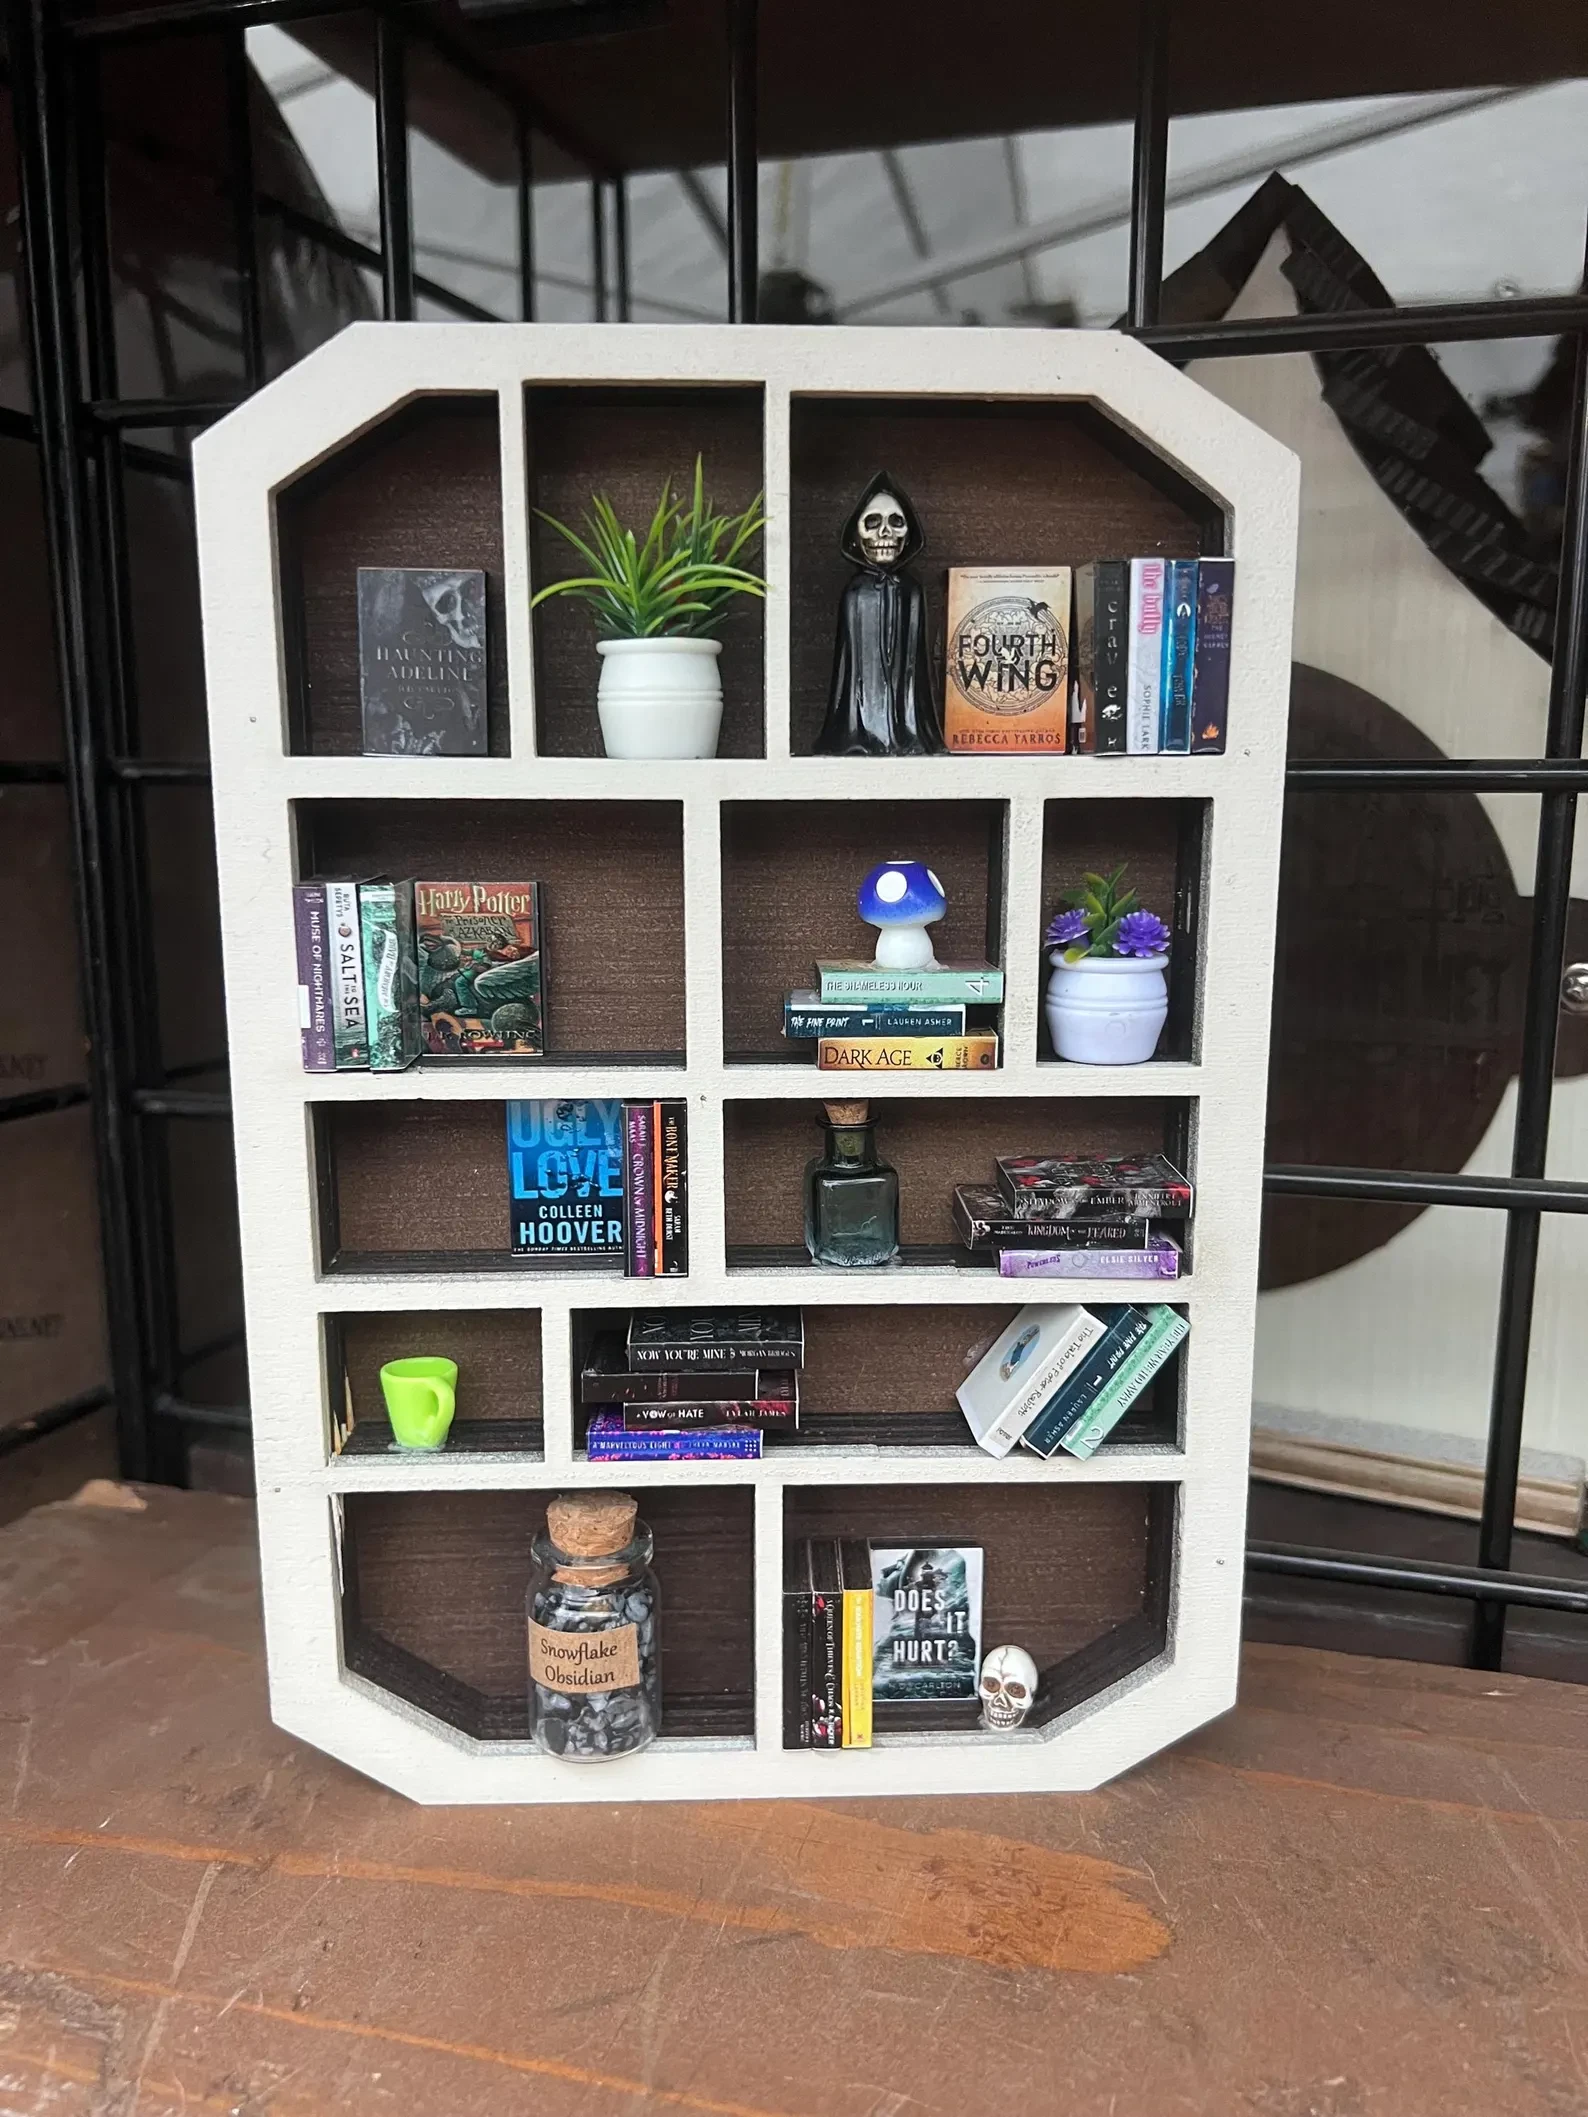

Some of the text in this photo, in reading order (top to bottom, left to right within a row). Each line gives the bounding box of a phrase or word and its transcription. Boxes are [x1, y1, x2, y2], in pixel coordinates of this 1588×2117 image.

[376, 646, 482, 663] HAUNTING
[958, 633, 1056, 657] FOURTH
[388, 666, 473, 681] ADELINE
[956, 660, 1057, 692] WING
[1142, 684, 1151, 720] SOPHIE
[952, 733, 1061, 745] REBECCA YARROS
[1141, 724, 1150, 750] LARK
[418, 885, 531, 917] Harry Potter
[309, 911, 321, 943] MUSE
[311, 945, 322, 960] OF
[340, 943, 358, 984] SALT
[827, 981, 923, 991] THE SHAMELESS HOUR
[312, 964, 326, 1033] NIGHTMARES
[344, 996, 361, 1029] SEA
[791, 1015, 850, 1028] THE FINE PRINT
[887, 1018, 952, 1026] LAUREN ASHER
[825, 1047, 912, 1069] DARK AGE
[510, 1100, 623, 1148] UGLY
[665, 1126, 678, 1153] BONE
[512, 1151, 623, 1199] LOVE
[633, 1153, 645, 1195] CROWN
[663, 1153, 680, 1189] MAKER
[539, 1204, 603, 1219] COLLEEN
[520, 1220, 622, 1245] HOOVER
[634, 1208, 647, 1258] MIDNIGHT
[1027, 1224, 1070, 1240] KINGDOM
[1100, 1255, 1126, 1264] ELSIE
[1078, 1327, 1094, 1342] The
[637, 1348, 727, 1361] NOW YOU'RE MINE
[1107, 1346, 1125, 1370] PRINT
[1040, 1367, 1060, 1391] Peter
[642, 1409, 667, 1419] VOW
[678, 1408, 704, 1419] HATE
[1017, 1389, 1042, 1416] Rabbit
[1044, 1393, 1088, 1444] LAUREN ASHER
[1083, 1425, 1105, 1450] 2
[894, 1589, 946, 1612] DOES
[946, 1611, 967, 1634] IT
[540, 1638, 618, 1666] Snowflake
[893, 1640, 959, 1662] HURT?
[545, 1665, 615, 1686] Obsidian
[914, 1681, 961, 1689] CARLTON
